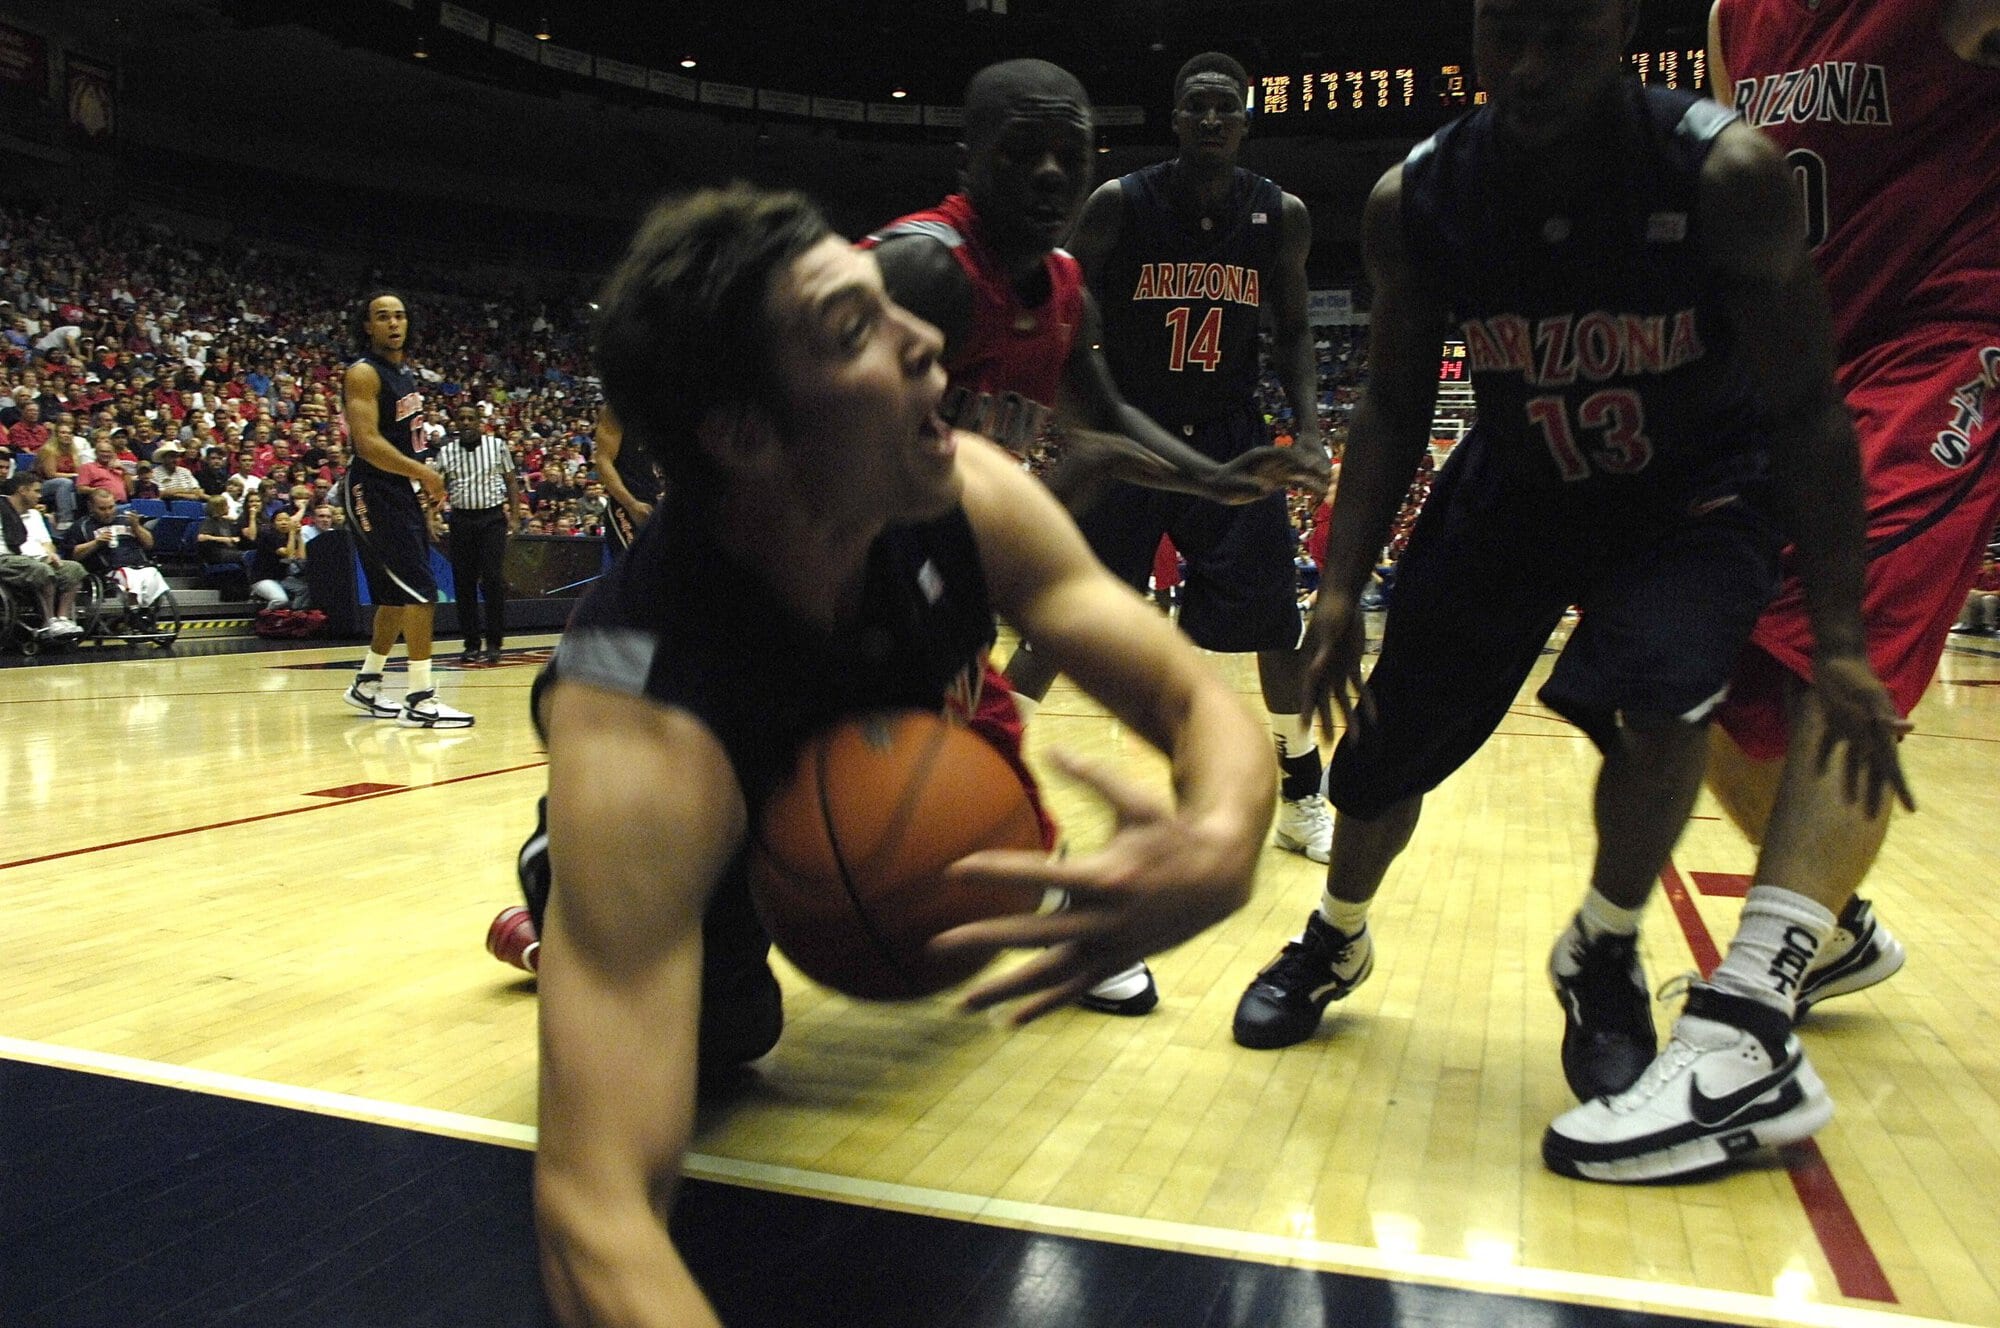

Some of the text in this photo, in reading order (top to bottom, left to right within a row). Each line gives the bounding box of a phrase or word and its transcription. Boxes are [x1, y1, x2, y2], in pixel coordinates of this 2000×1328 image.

[1303, 74, 1314, 84] 5
[1320, 72, 1339, 83] 20
[1345, 71, 1363, 83] 34
[1370, 69, 1389, 81] 50
[1395, 68, 1414, 79] 54
[1303, 83, 1314, 94] 2
[1327, 81, 1339, 92] 0
[1377, 79, 1389, 89] 0
[1403, 78, 1414, 88] 2
[1377, 89, 1389, 99] 0
[1403, 88, 1414, 98] 2
[1327, 100, 1338, 110] 0
[1352, 99, 1363, 109] 0
[1377, 98, 1388, 108] 0
[1133, 262, 1260, 308] ARIZONA
[1165, 307, 1224, 372] 14
[1525, 387, 1654, 481] 13
